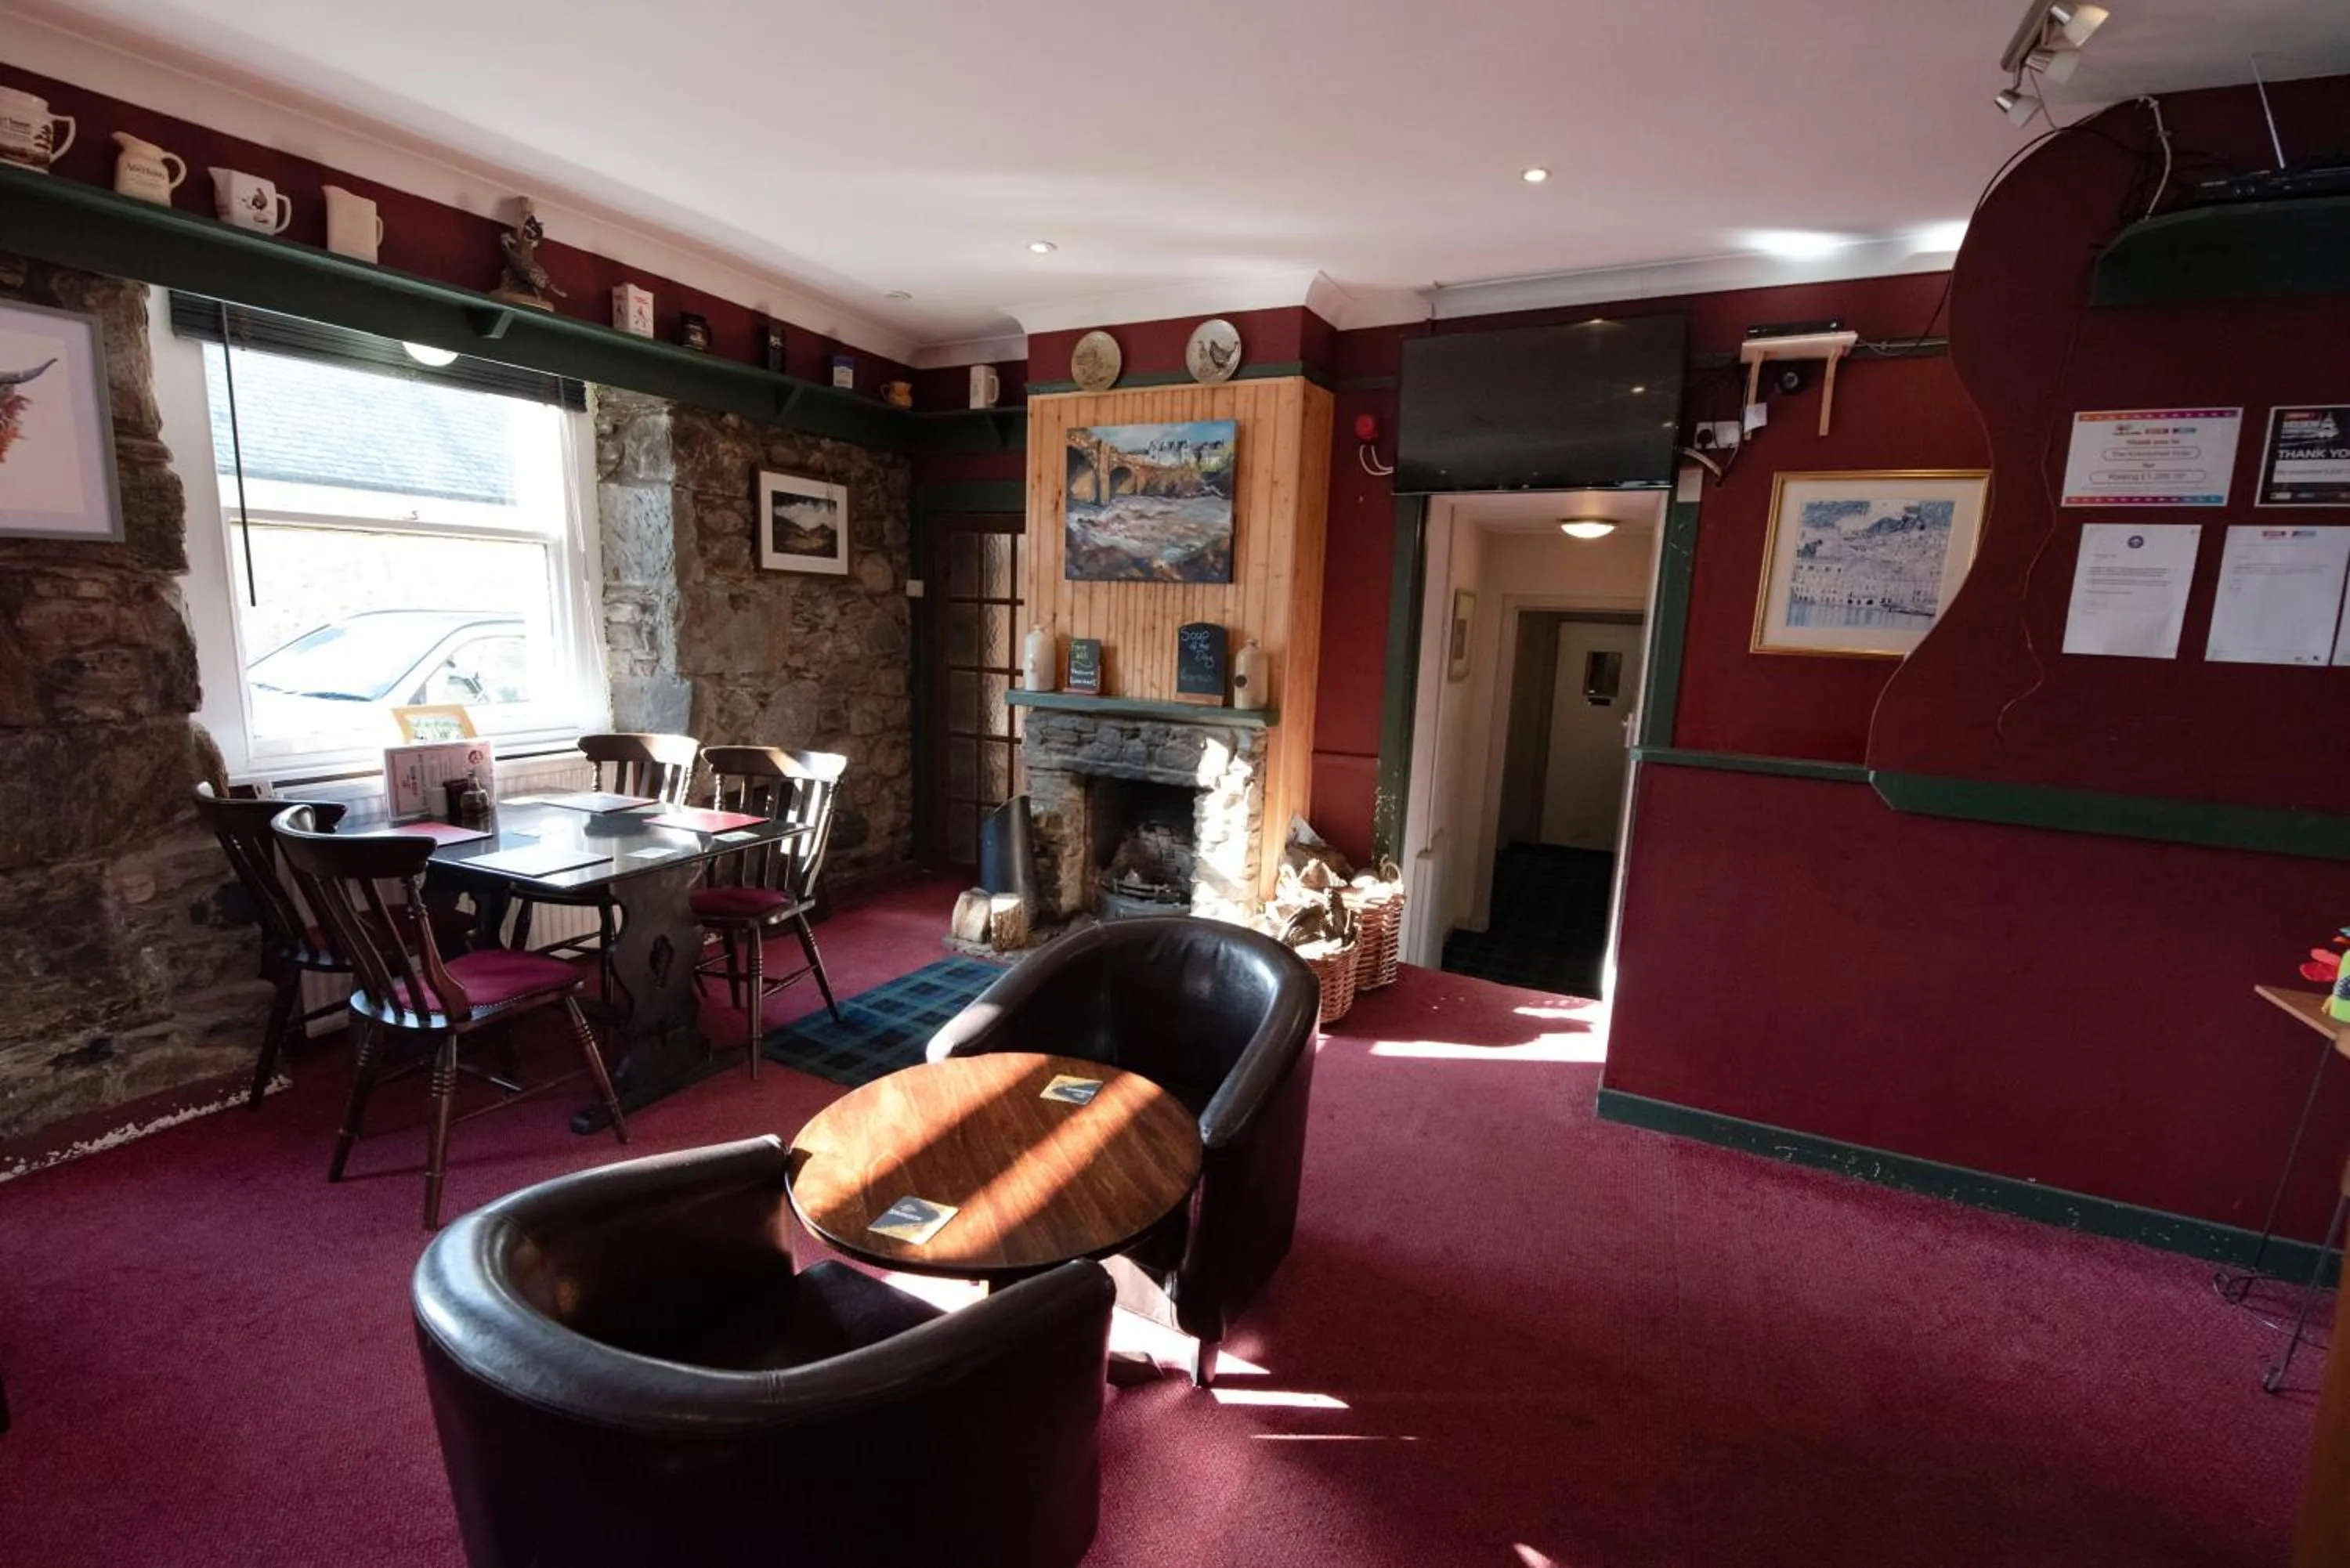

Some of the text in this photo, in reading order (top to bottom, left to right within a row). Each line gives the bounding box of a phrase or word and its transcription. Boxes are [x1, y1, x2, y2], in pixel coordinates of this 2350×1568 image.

[2279, 448, 2350, 458] THANK YO
[1180, 627, 1210, 641] Soup
